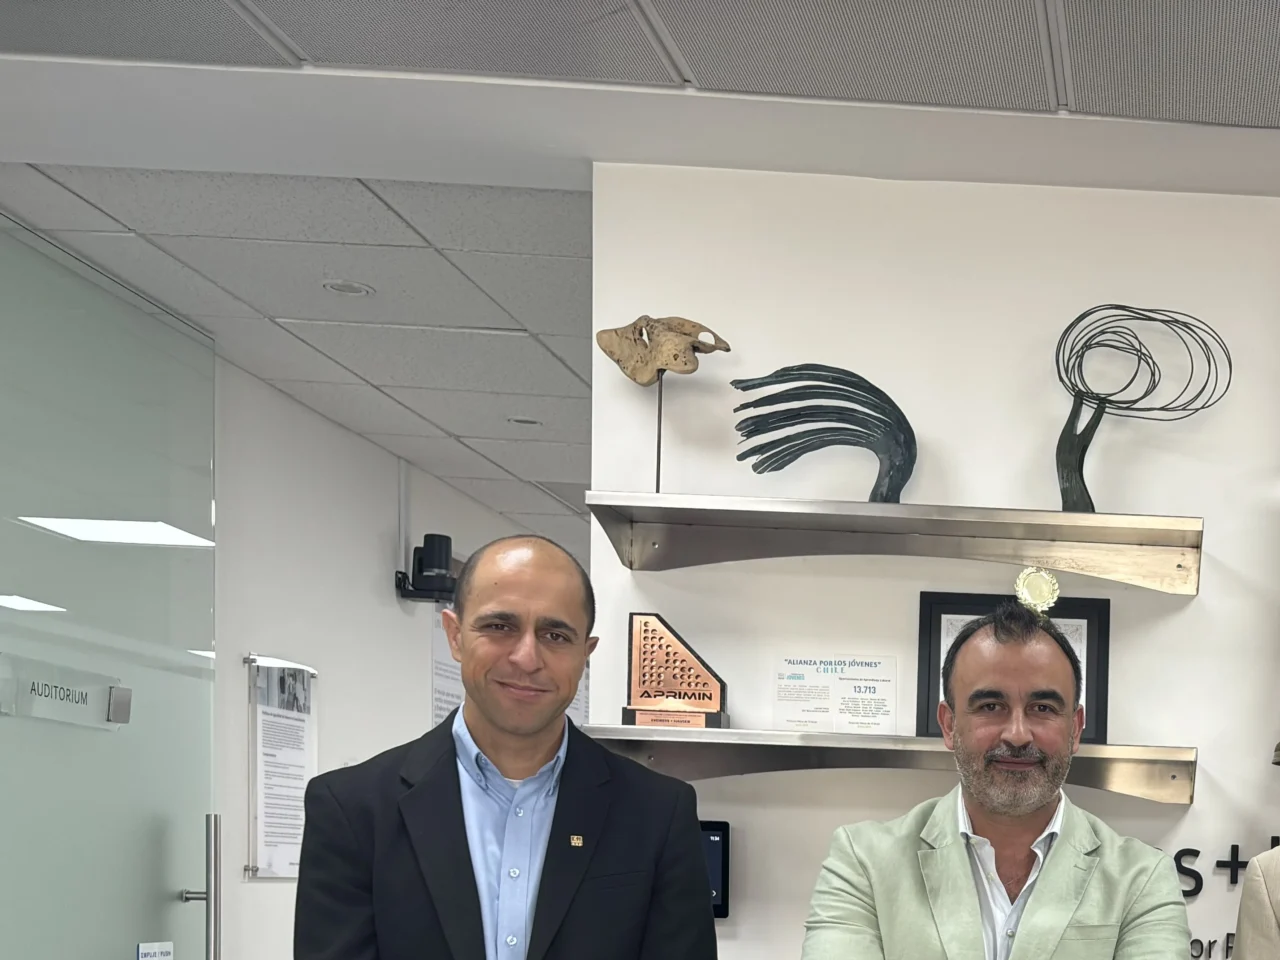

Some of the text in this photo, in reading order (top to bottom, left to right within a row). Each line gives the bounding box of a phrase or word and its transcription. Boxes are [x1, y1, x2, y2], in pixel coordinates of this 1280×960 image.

[30, 681, 88, 706] AUDITORIUM
[639, 690, 712, 701] APRIMIN
[853, 685, 877, 694] 13.713
[1190, 938, 1217, 959] or
